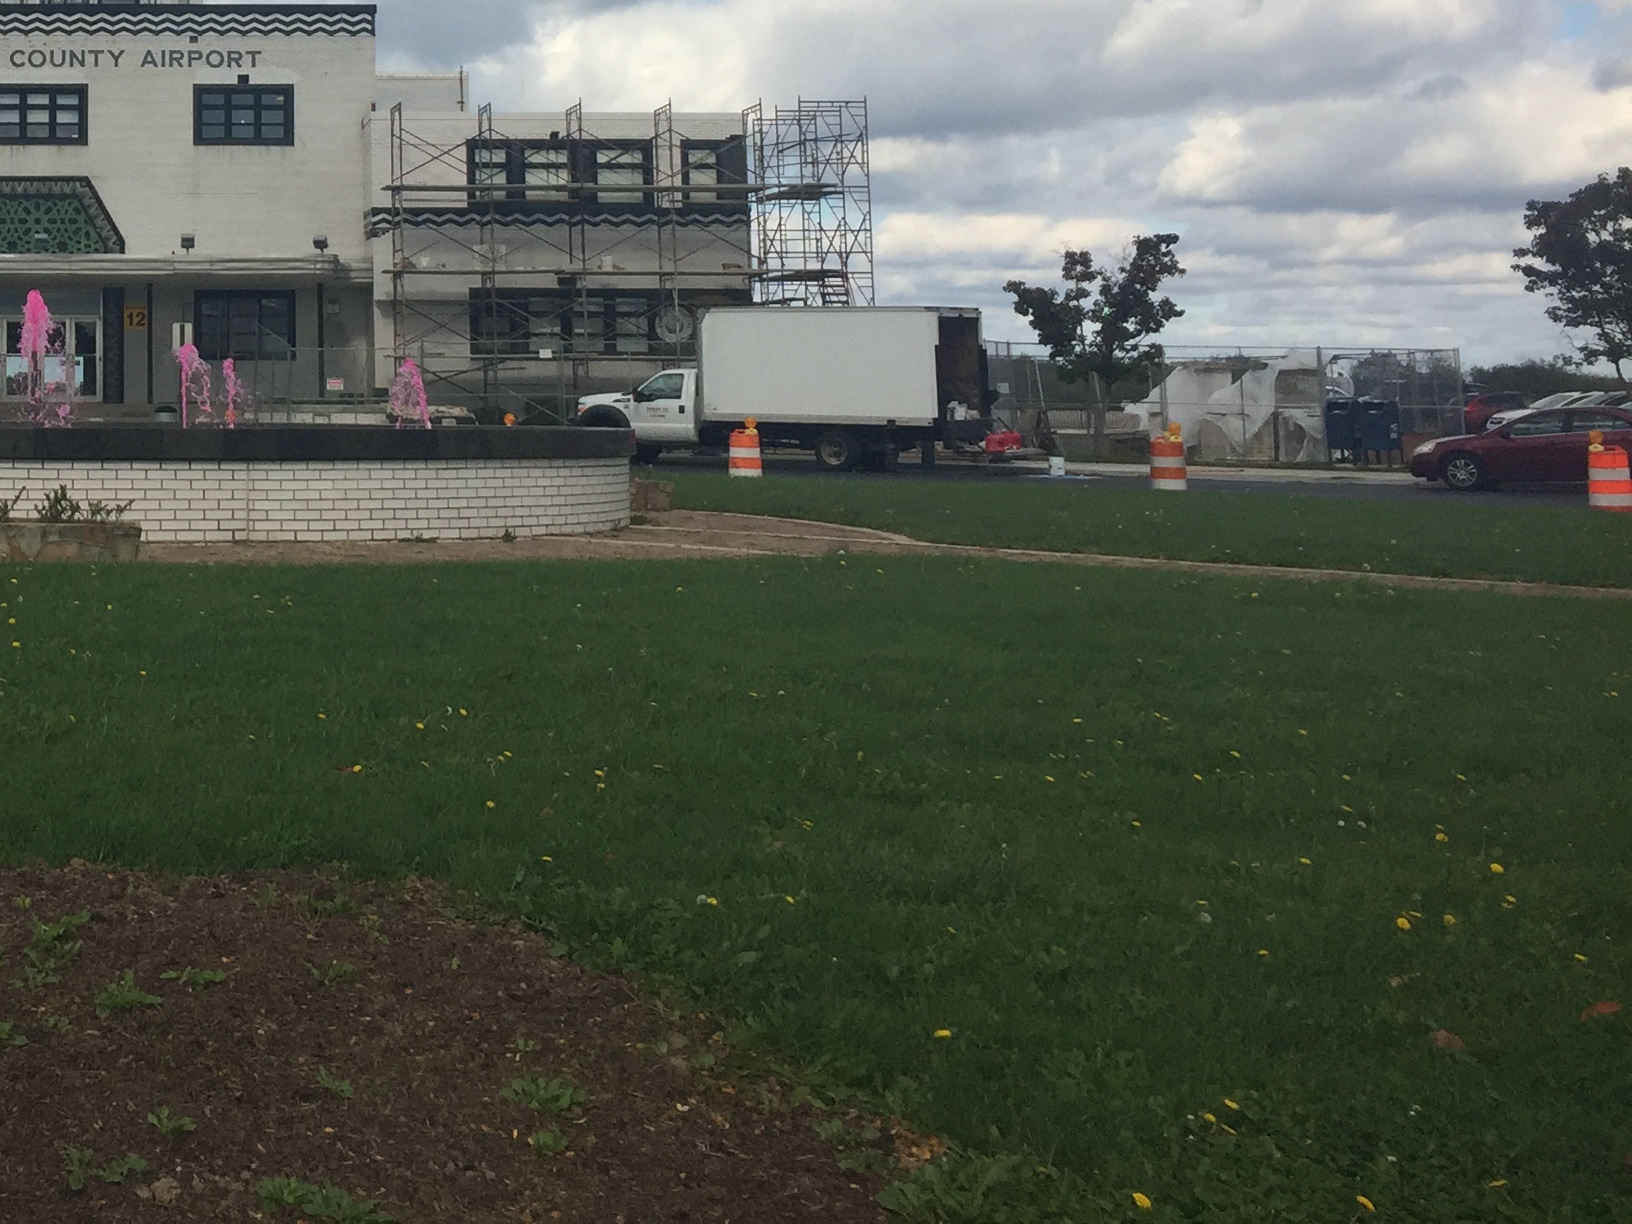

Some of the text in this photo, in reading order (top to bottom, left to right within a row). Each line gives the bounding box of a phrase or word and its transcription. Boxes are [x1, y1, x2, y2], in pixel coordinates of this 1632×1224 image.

[9, 49, 126, 68] COUNTY
[140, 49, 263, 68] AIRPORT
[126, 311, 146, 327] 12
